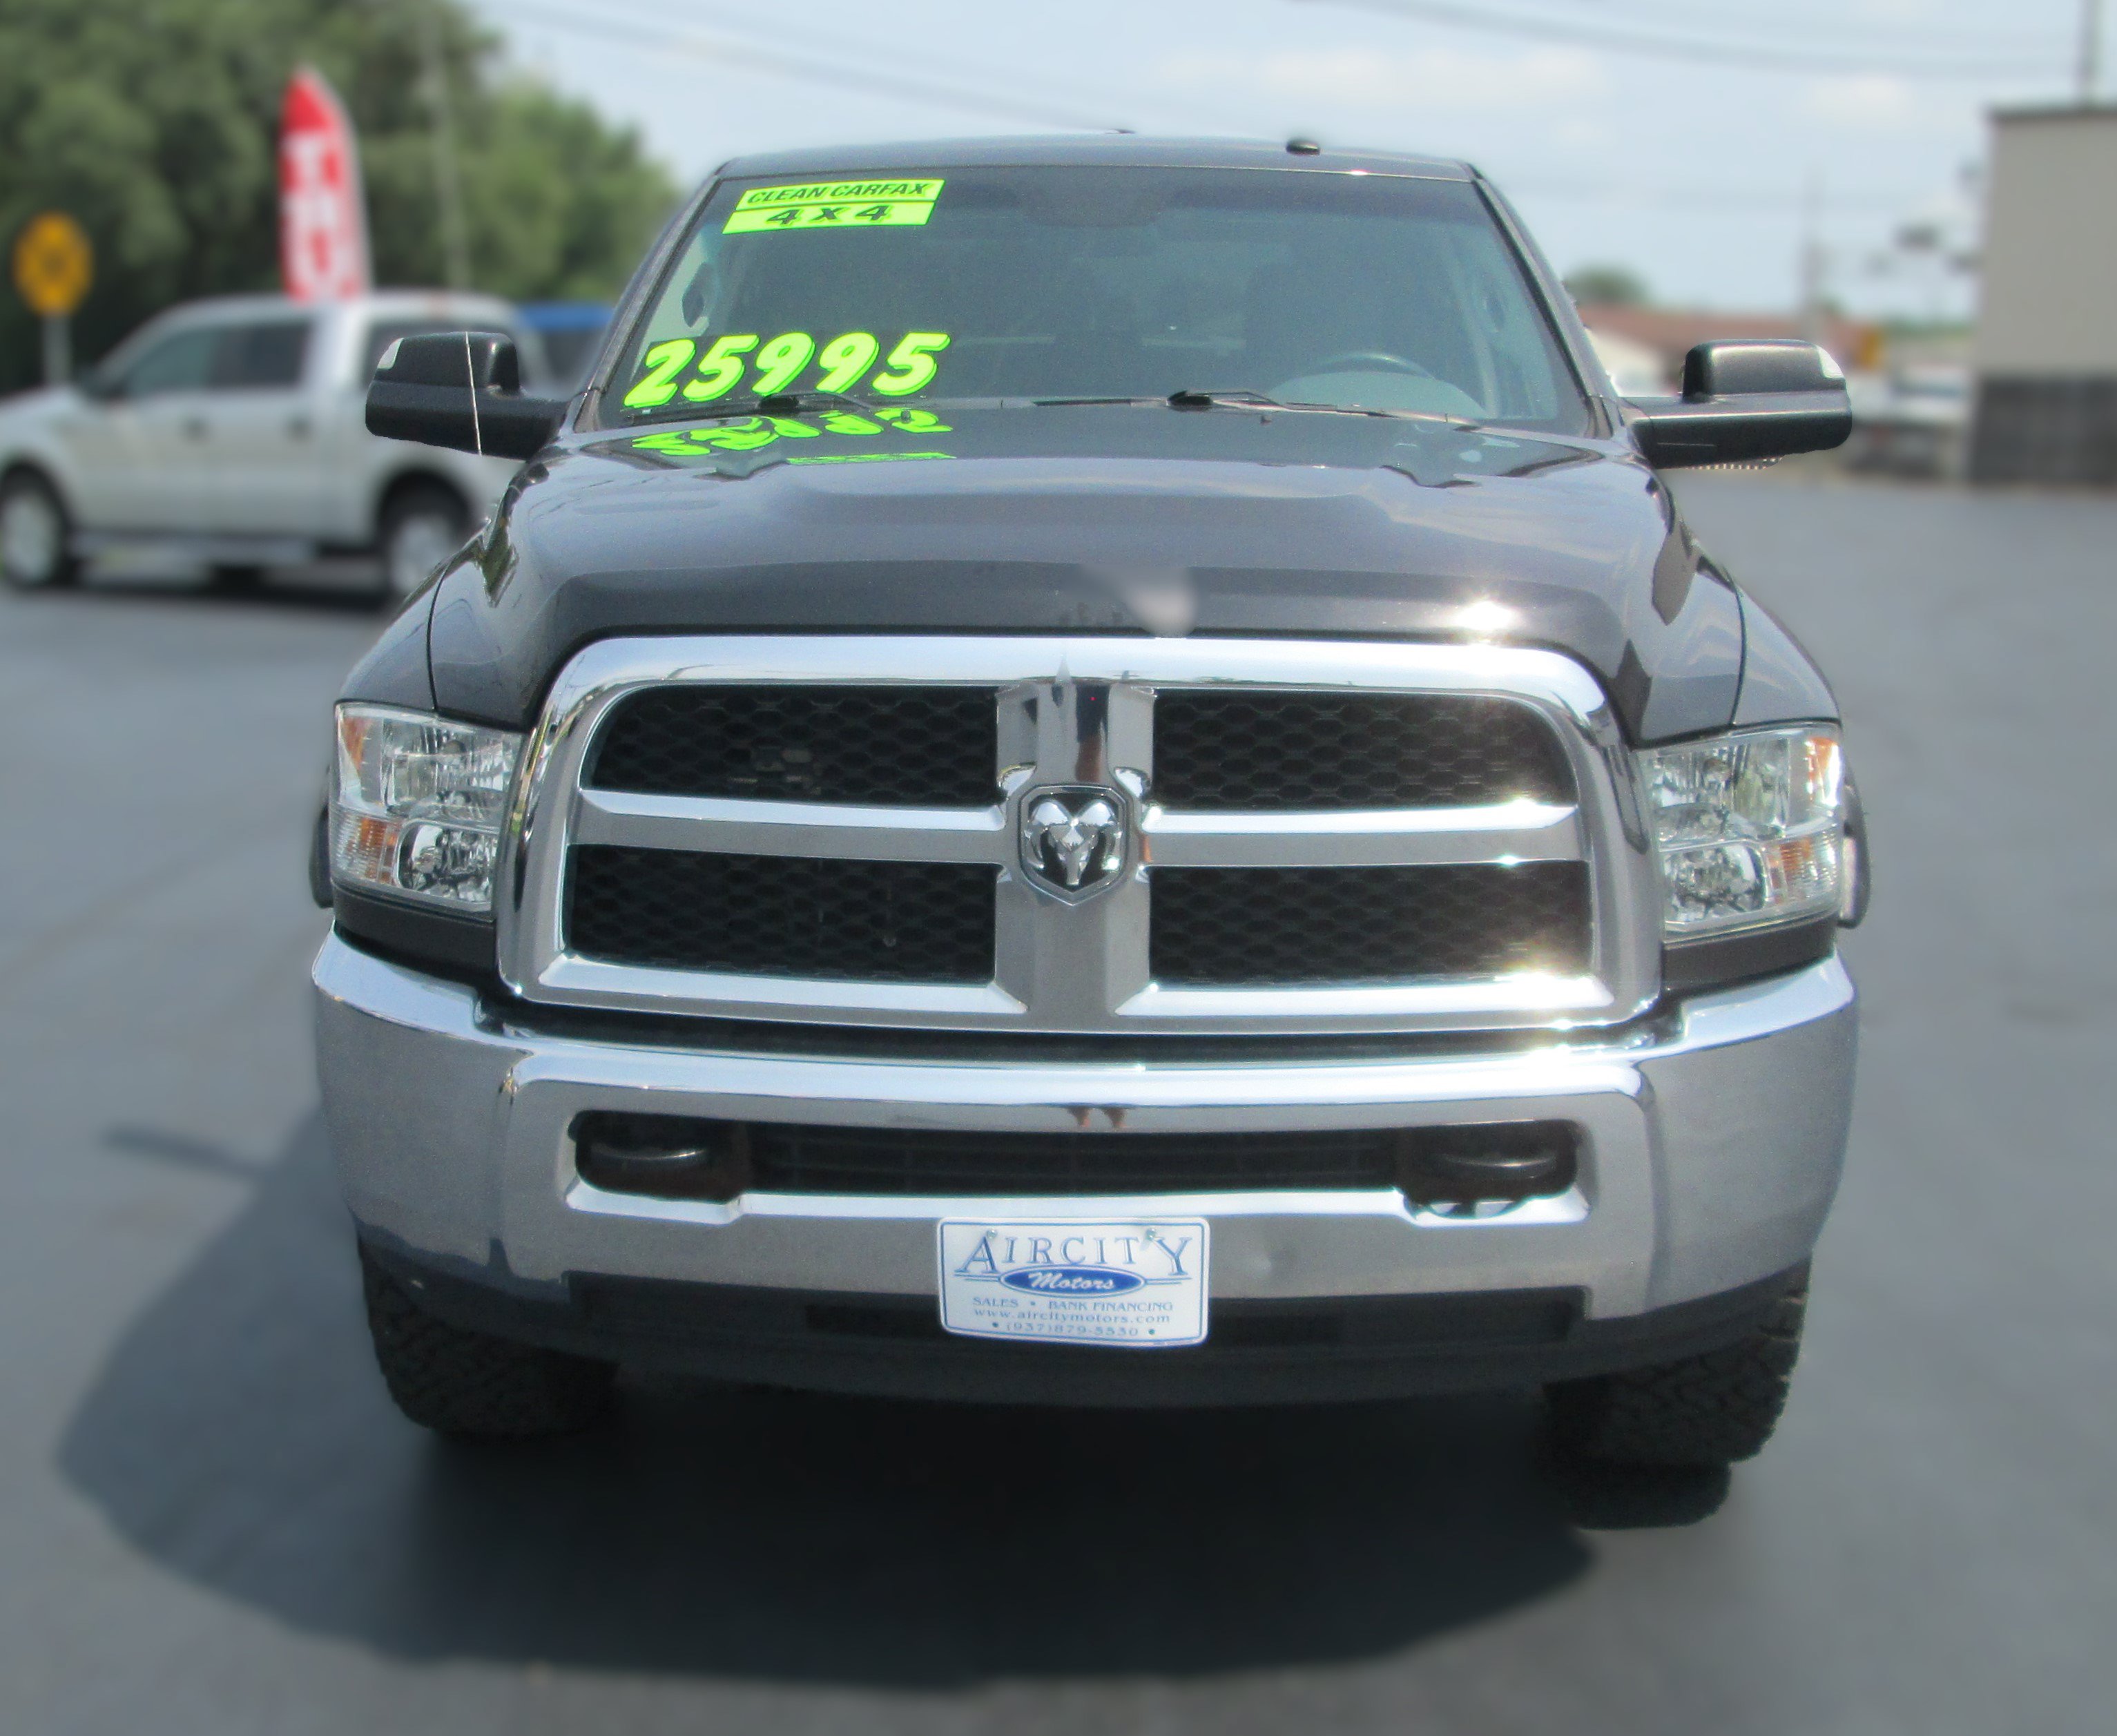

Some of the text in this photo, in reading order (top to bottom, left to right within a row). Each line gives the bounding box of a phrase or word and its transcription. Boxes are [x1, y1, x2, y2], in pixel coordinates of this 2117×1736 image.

[748, 184, 928, 204] CLEAN CARFAX
[624, 332, 951, 407] 25995
[956, 1236, 1192, 1276] AIRCITY
[1029, 1271, 1114, 1290] Motors
[973, 1297, 1174, 1312] SALES BANK FINANCING
[974, 1308, 1170, 1324] www.aircitymotors.com
